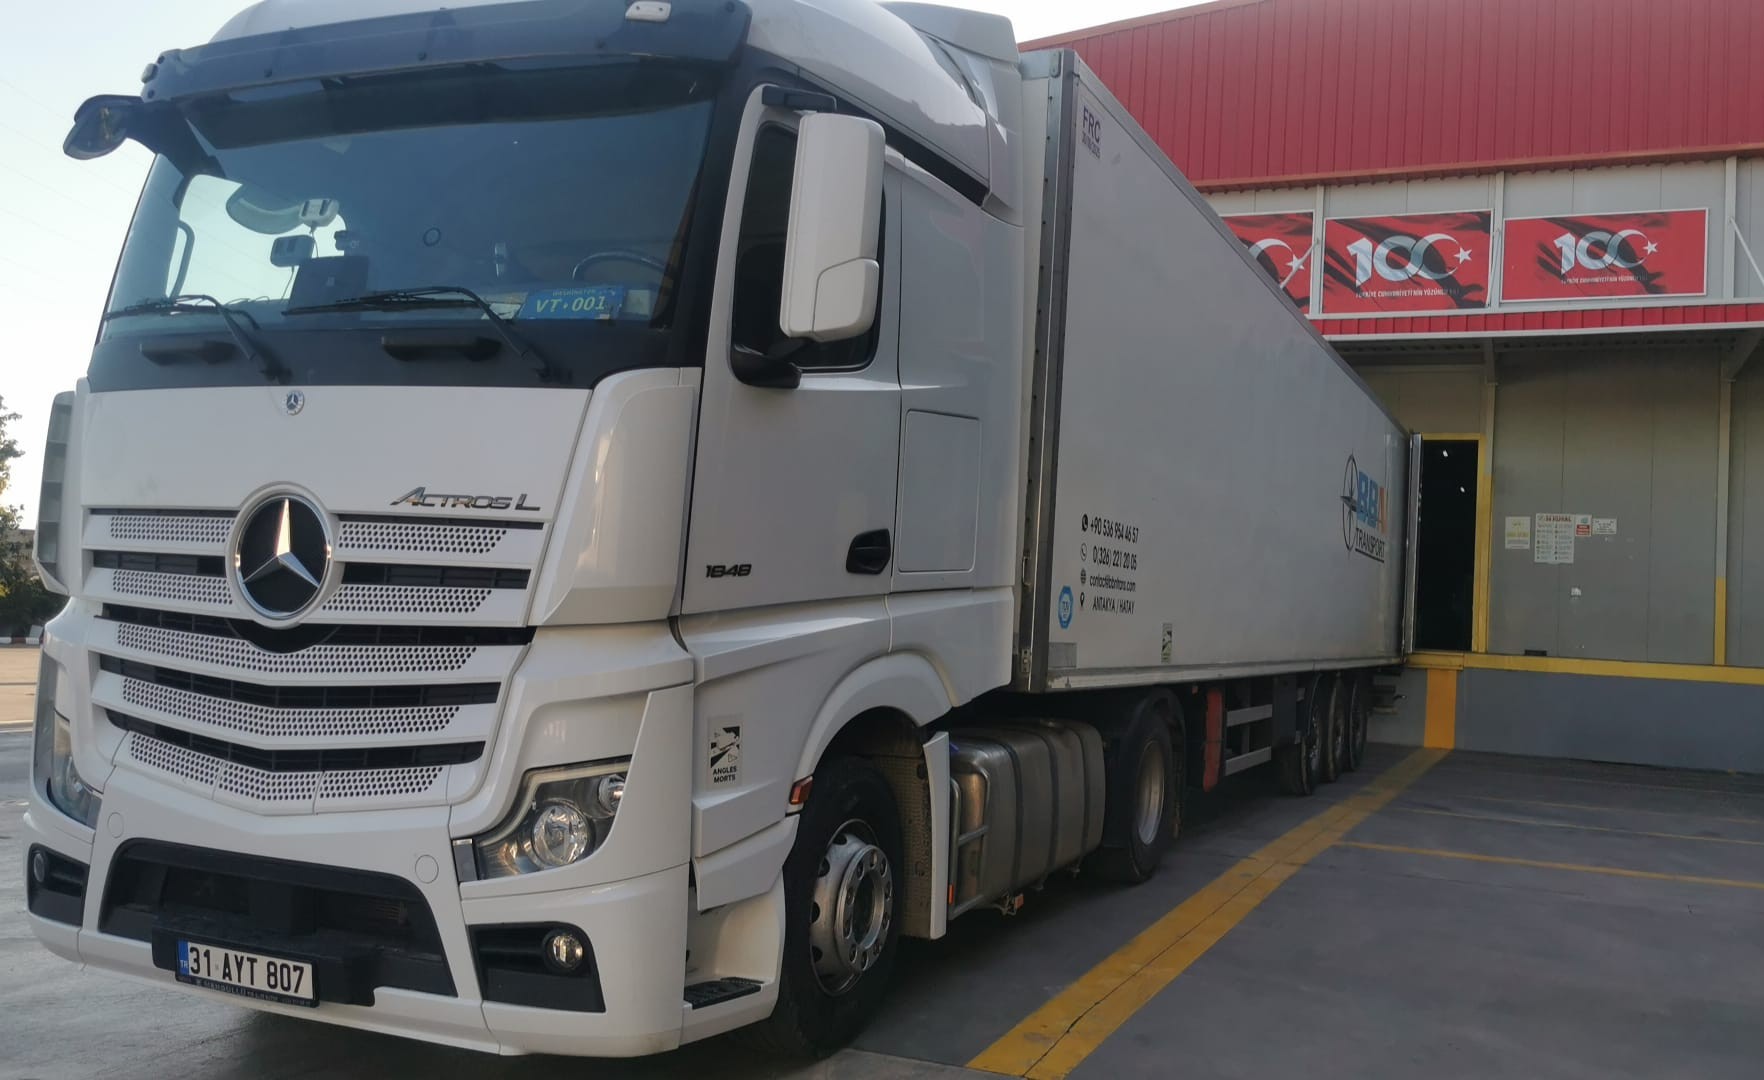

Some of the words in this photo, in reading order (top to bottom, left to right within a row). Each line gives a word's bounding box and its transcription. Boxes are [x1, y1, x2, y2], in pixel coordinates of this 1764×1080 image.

[1083, 105, 1101, 144] FRC
[515, 493, 541, 511] L
[1090, 517, 1102, 536] +90
[1103, 519, 1114, 538] 536
[1114, 522, 1124, 540] 954
[1125, 525, 1132, 543] 46
[1132, 527, 1139, 544] 57
[1355, 527, 1385, 559] TRANSPORT
[1093, 545, 1112, 568] 0(326)
[1112, 550, 1122, 568] 221
[1123, 552, 1130, 569] 20
[705, 563, 752, 578] 1848
[1092, 596, 1115, 613] ANTAKYA
[1119, 599, 1136, 615] HATAY
[713, 765, 737, 775] ANGLES
[713, 774, 736, 784] MORTS
[189, 946, 211, 977] 31
[222, 952, 258, 986] AYT
[266, 961, 305, 994] 807
